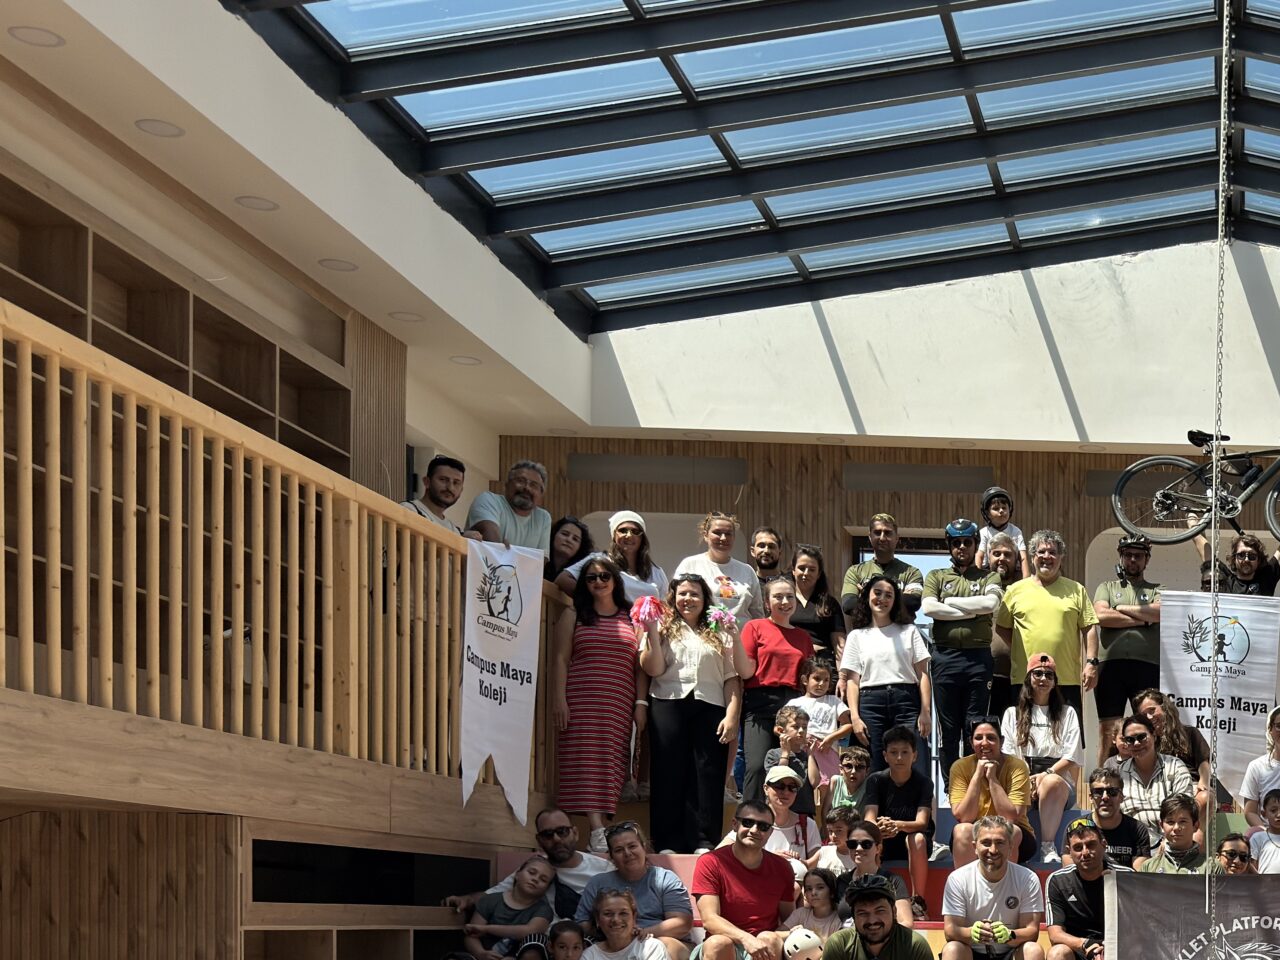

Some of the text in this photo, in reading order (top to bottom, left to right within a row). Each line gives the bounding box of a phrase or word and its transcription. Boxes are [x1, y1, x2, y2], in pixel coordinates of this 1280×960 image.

[476, 615, 506, 634] Campus
[466, 645, 533, 686] Campus Maya
[1189, 664, 1224, 677] Camps
[1224, 665, 1247, 677] Maya
[478, 678, 507, 706] Koleji
[1229, 696, 1268, 716] Maya
